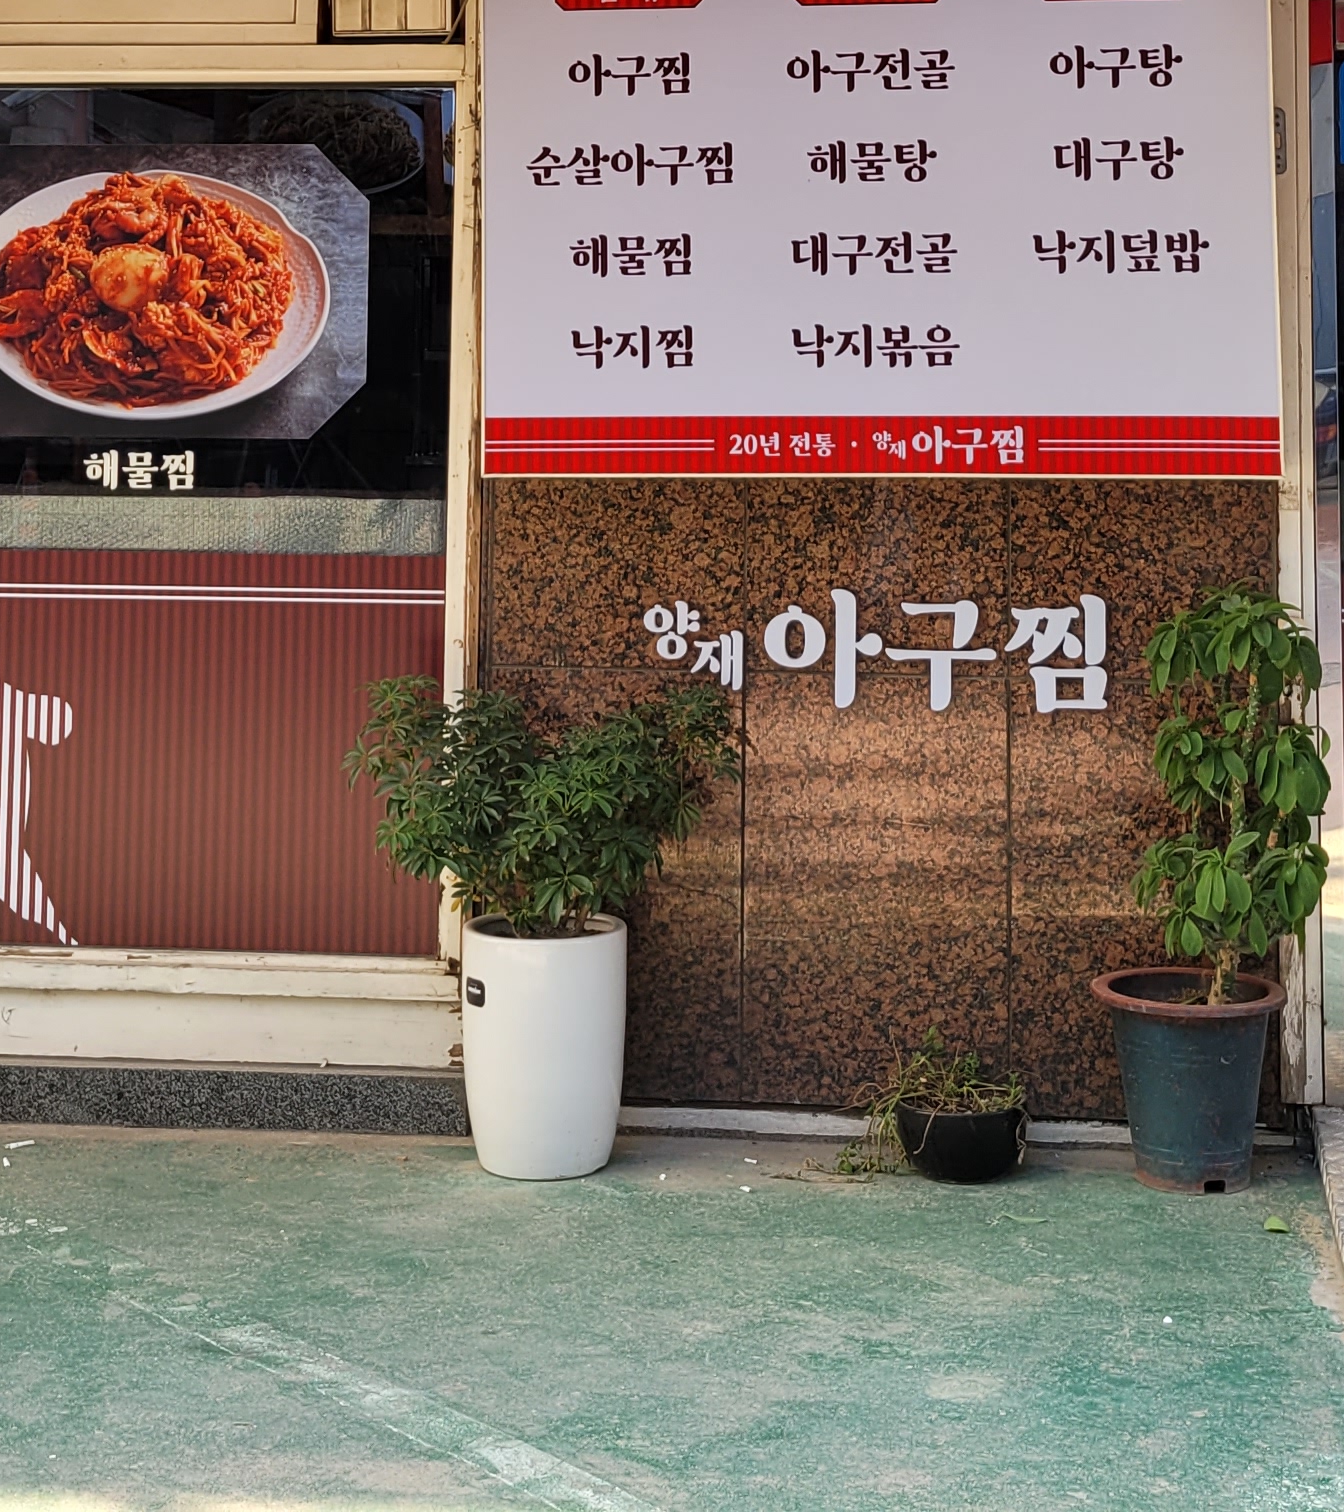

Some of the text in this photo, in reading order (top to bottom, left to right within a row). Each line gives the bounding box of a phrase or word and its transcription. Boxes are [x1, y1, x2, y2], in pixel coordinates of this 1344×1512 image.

[568, 51, 691, 96] 아구찜
[787, 48, 955, 93] 아구전골
[1049, 44, 1183, 88] 아구탕
[526, 141, 734, 186] 순살아구찜
[808, 139, 937, 184] 해물탕
[1054, 135, 1184, 180] 대구탕
[570, 233, 693, 278] 해물찜
[791, 231, 958, 276] 대구전골
[1034, 228, 1209, 274] 낙지덮밥
[571, 325, 695, 370] 낙지찜
[791, 323, 959, 369] 낙지볶음
[729, 425, 1025, 466] 20년 전통 양재 아구찜
[83, 449, 195, 490] 해물찜
[643, 589, 1107, 713] 양재 아구찜
